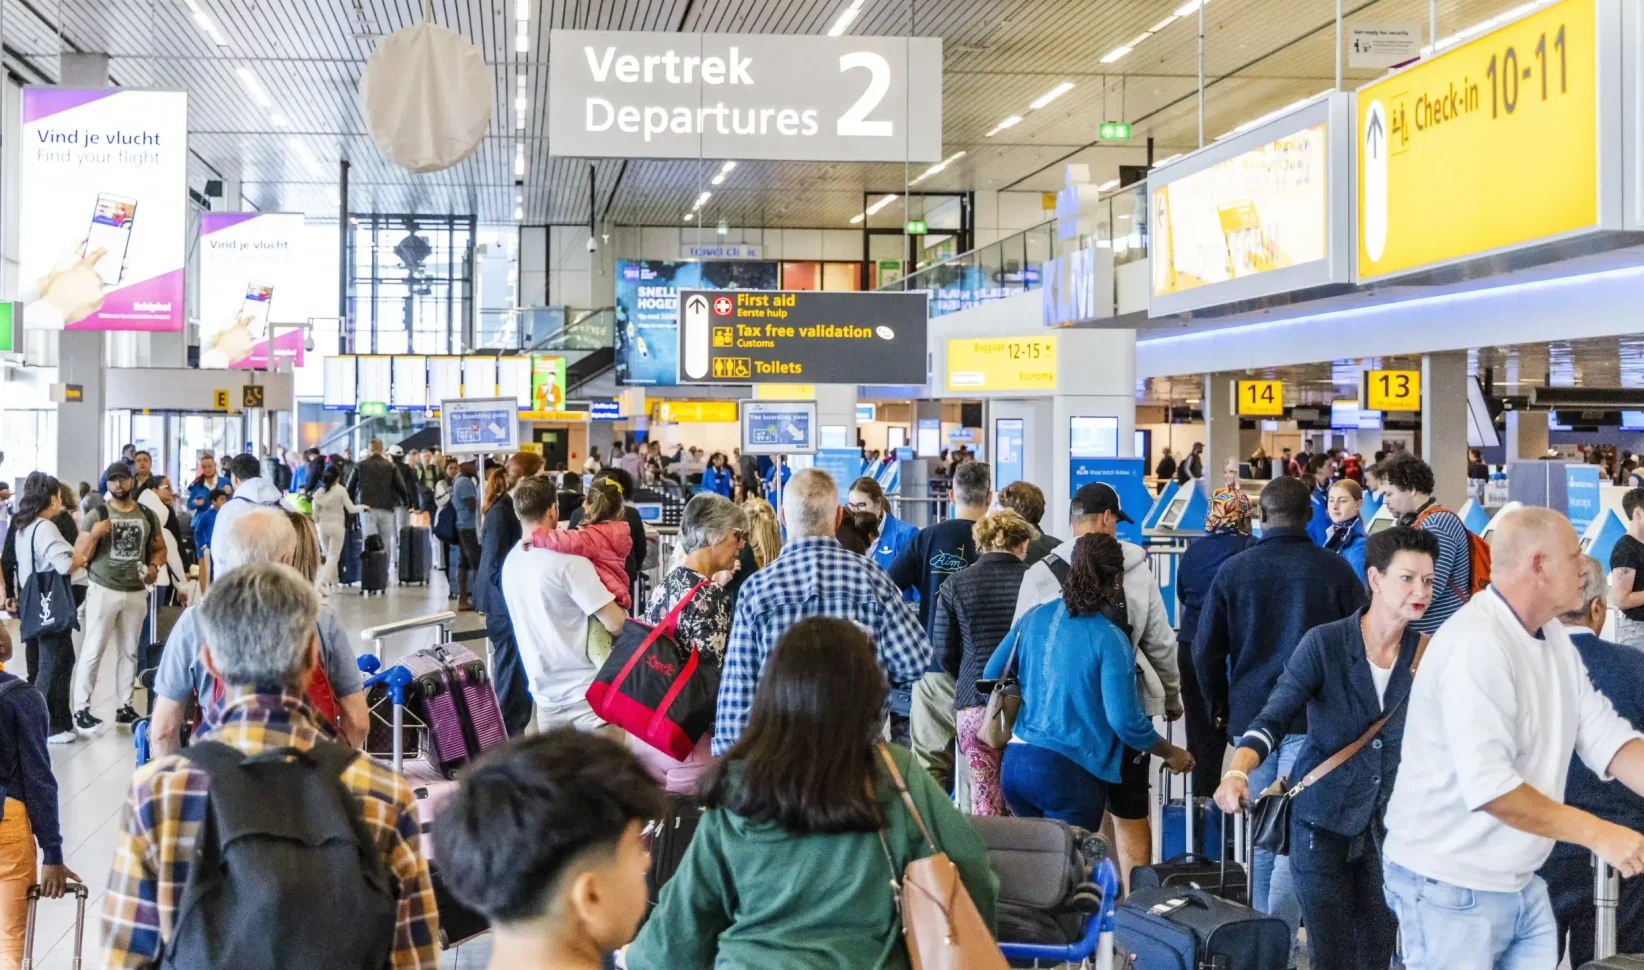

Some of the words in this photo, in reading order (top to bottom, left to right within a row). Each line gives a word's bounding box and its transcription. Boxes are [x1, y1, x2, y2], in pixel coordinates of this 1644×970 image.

[584, 46, 754, 85] Vertrek
[1415, 78, 1479, 131] Check-in
[1487, 25, 1567, 119] 10-11
[836, 51, 894, 137] 2
[585, 97, 818, 142] Departures
[37, 129, 79, 143] Vind
[84, 129, 100, 148] je
[106, 130, 161, 146] vlucht
[37, 147, 71, 163] Find
[76, 152, 112, 167] your
[119, 149, 160, 168] flight
[210, 239, 236, 249] Vind
[239, 241, 249, 252] je
[253, 240, 289, 250] vlucht
[736, 293, 769, 308] First
[772, 292, 796, 307] aid
[736, 308, 765, 319] Eerste
[766, 308, 788, 319] hulp
[736, 325, 762, 338] Tax
[765, 324, 794, 338] free
[798, 324, 872, 338] validation
[736, 338, 775, 349] Customs
[974, 342, 1004, 354] Baggage
[1007, 343, 1041, 360] 12-15
[754, 361, 803, 375] Toilets
[1018, 371, 1054, 382] Economy
[1247, 383, 1275, 404] 14
[1378, 374, 1410, 398] 13
[218, 391, 226, 406] E
